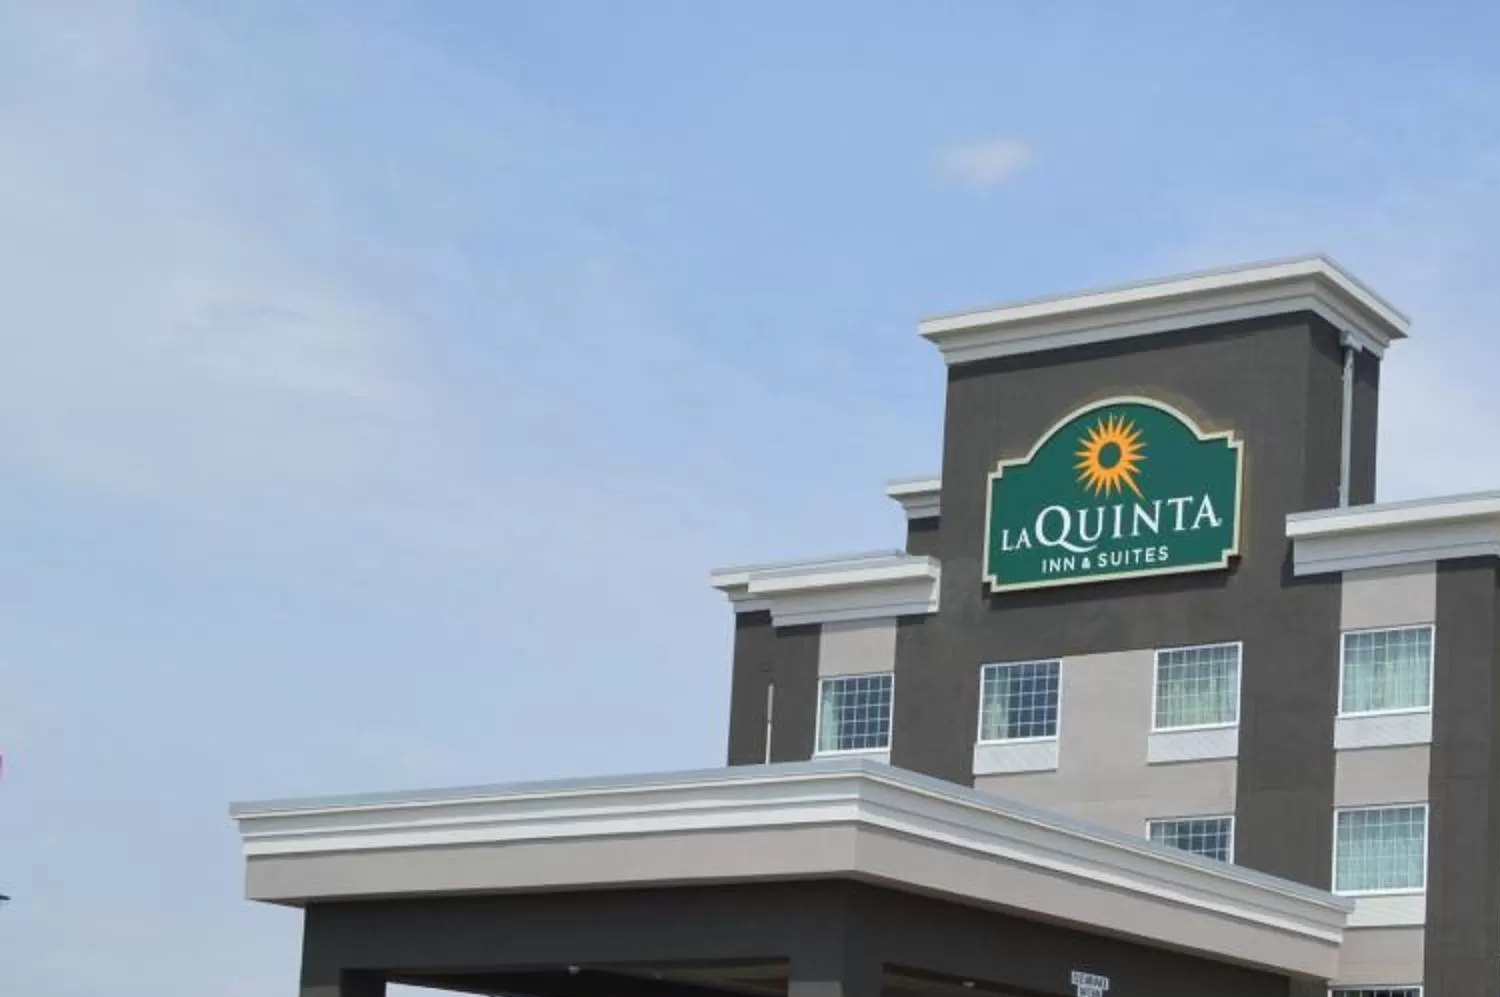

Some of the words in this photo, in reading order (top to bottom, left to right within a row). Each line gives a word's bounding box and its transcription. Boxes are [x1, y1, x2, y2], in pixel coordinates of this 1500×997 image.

[1001, 527, 1032, 551] LA
[1035, 493, 1223, 553] QUINTA
[1041, 557, 1076, 573] INN
[1081, 556, 1091, 569] &
[1098, 545, 1169, 567] SUITES
